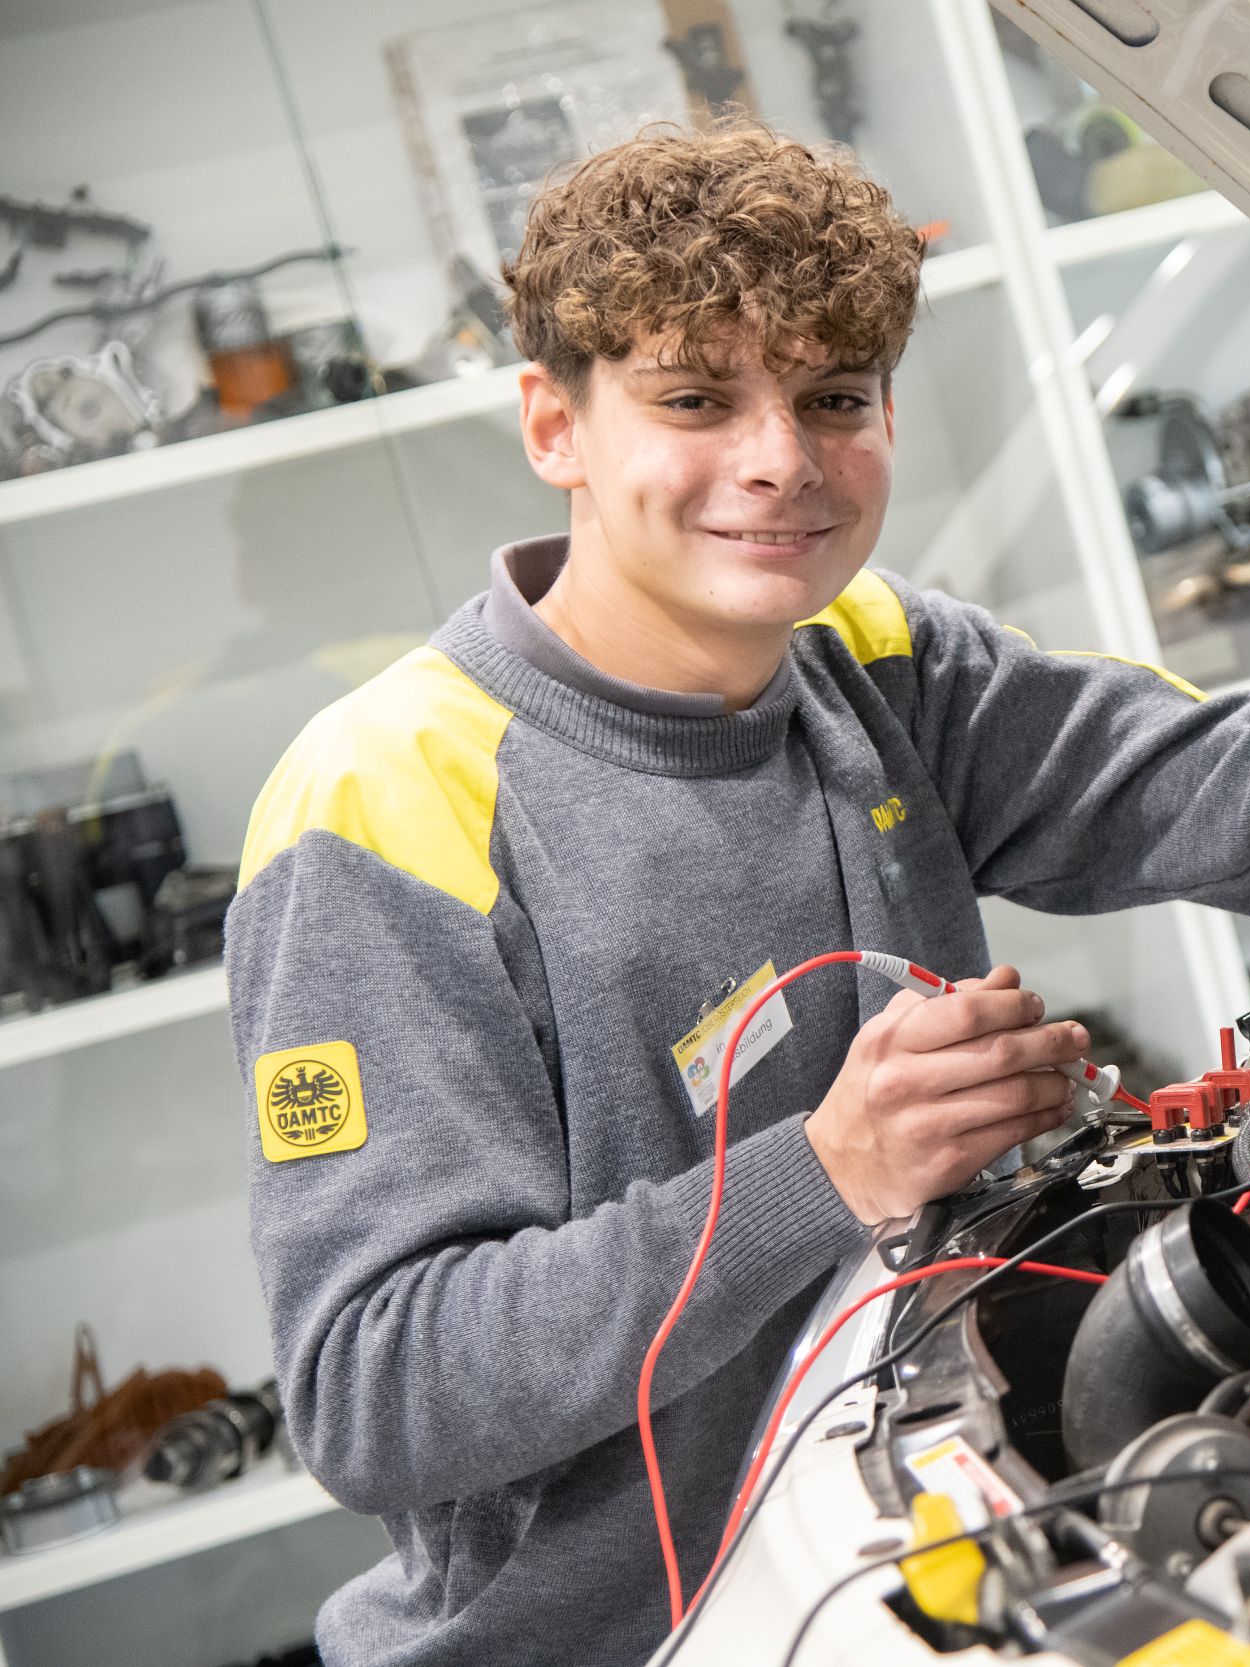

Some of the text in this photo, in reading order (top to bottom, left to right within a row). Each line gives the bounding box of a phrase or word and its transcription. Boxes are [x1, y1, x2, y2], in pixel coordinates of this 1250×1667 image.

[677, 1030, 702, 1055] ÖAMTC
[715, 1040, 727, 1056] in
[732, 1018, 773, 1063] sbildung
[277, 1103, 342, 1130] ÖAMTC
